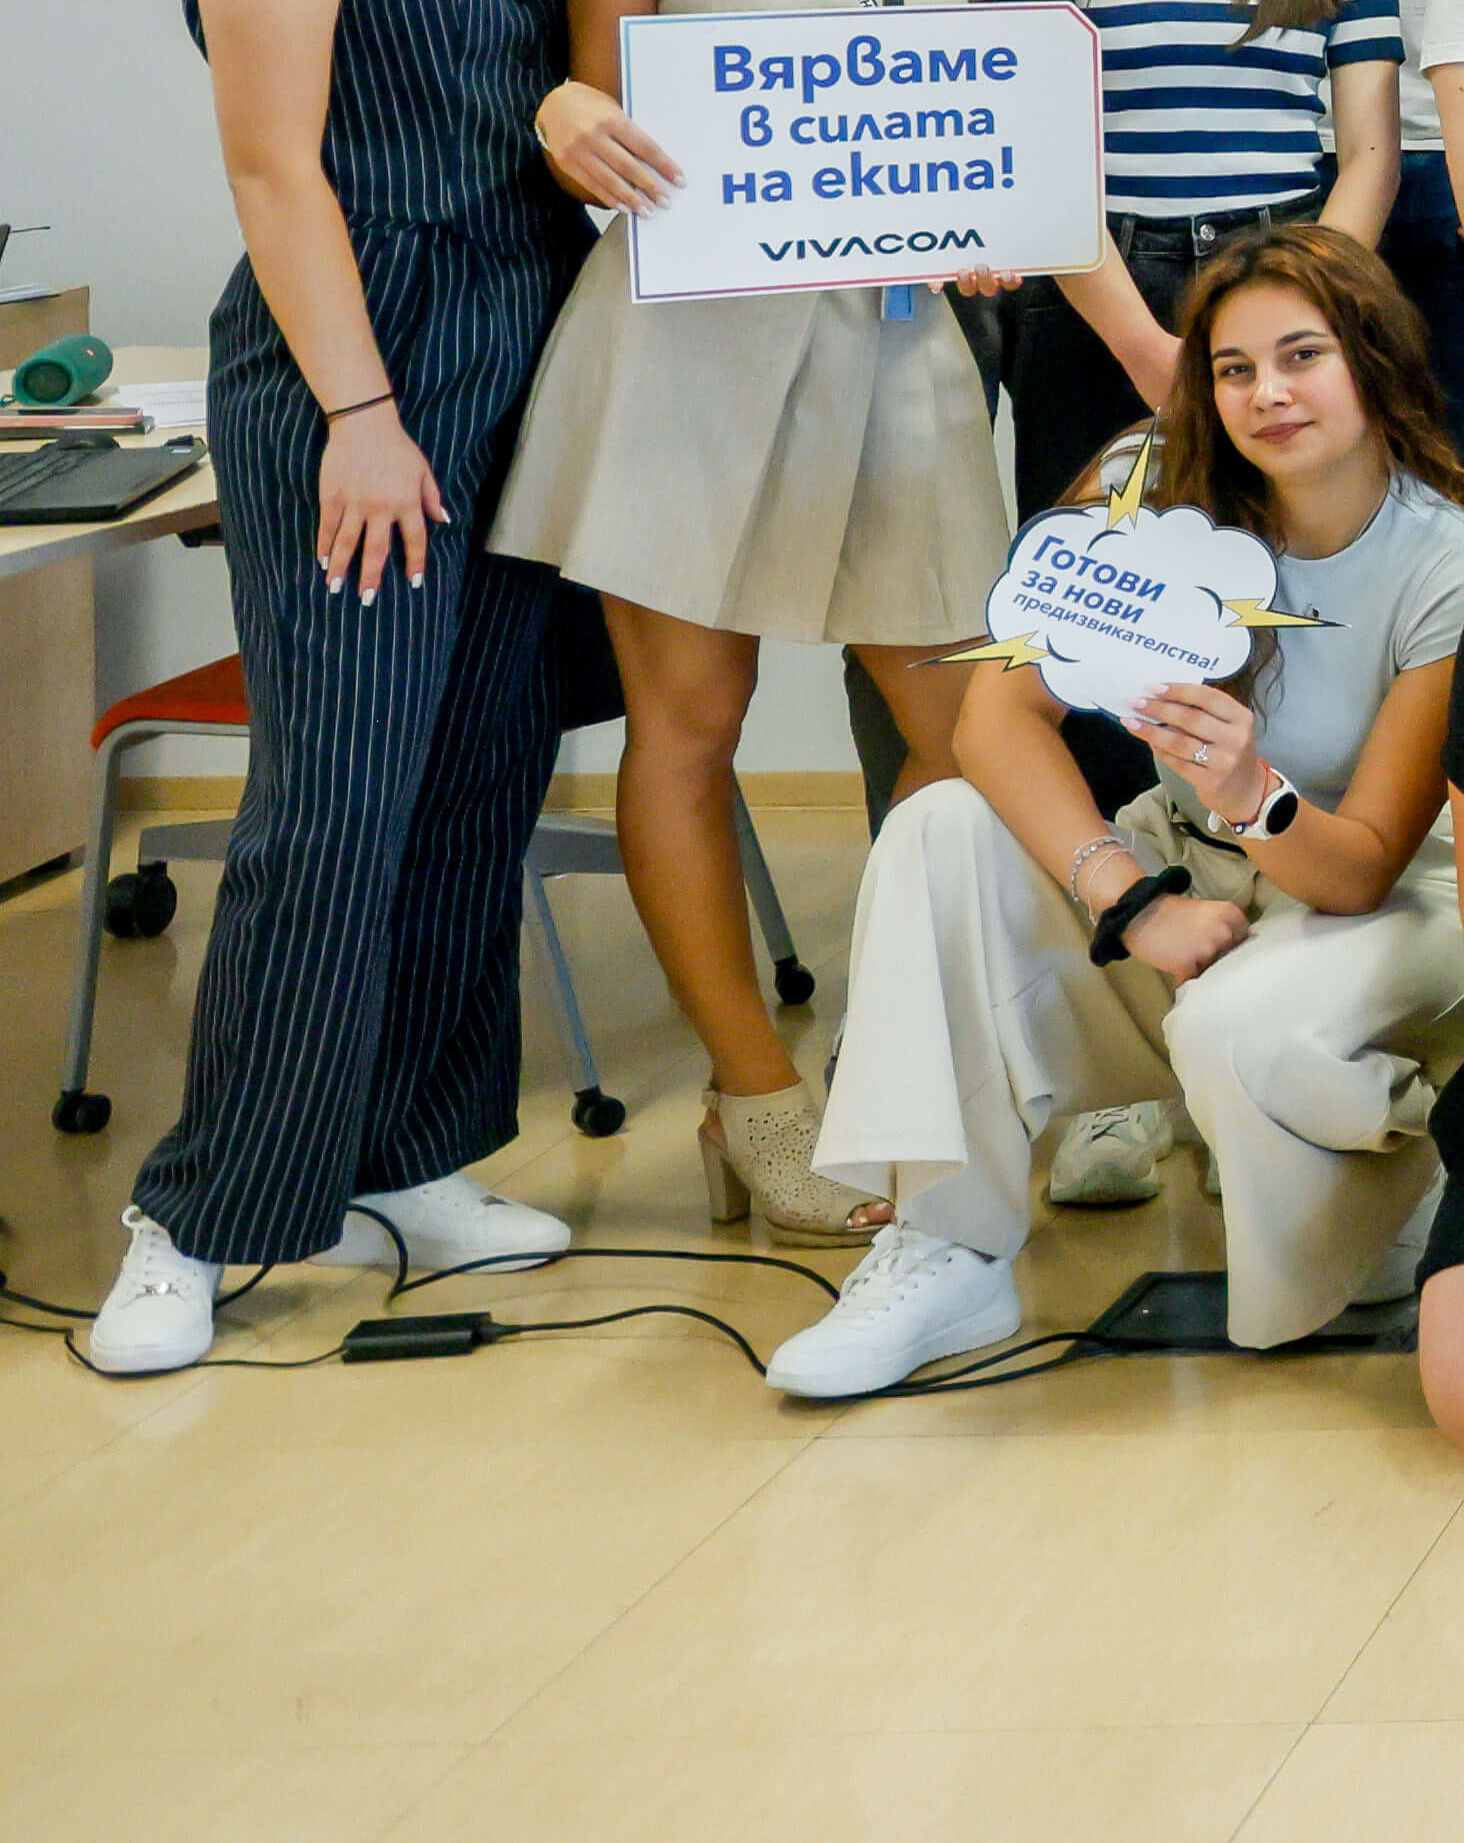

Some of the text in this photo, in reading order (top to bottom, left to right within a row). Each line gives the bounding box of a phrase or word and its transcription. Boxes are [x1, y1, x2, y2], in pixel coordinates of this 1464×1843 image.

[713, 34, 1018, 103] Вярваме
[740, 104, 995, 146] в силата
[722, 145, 1015, 204] на екипа!
[758, 228, 986, 261] VIVACOM
[1020, 569, 1146, 625] за нови
[1031, 534, 1167, 603] Готови
[1012, 592, 1221, 672] предизвикателства!
